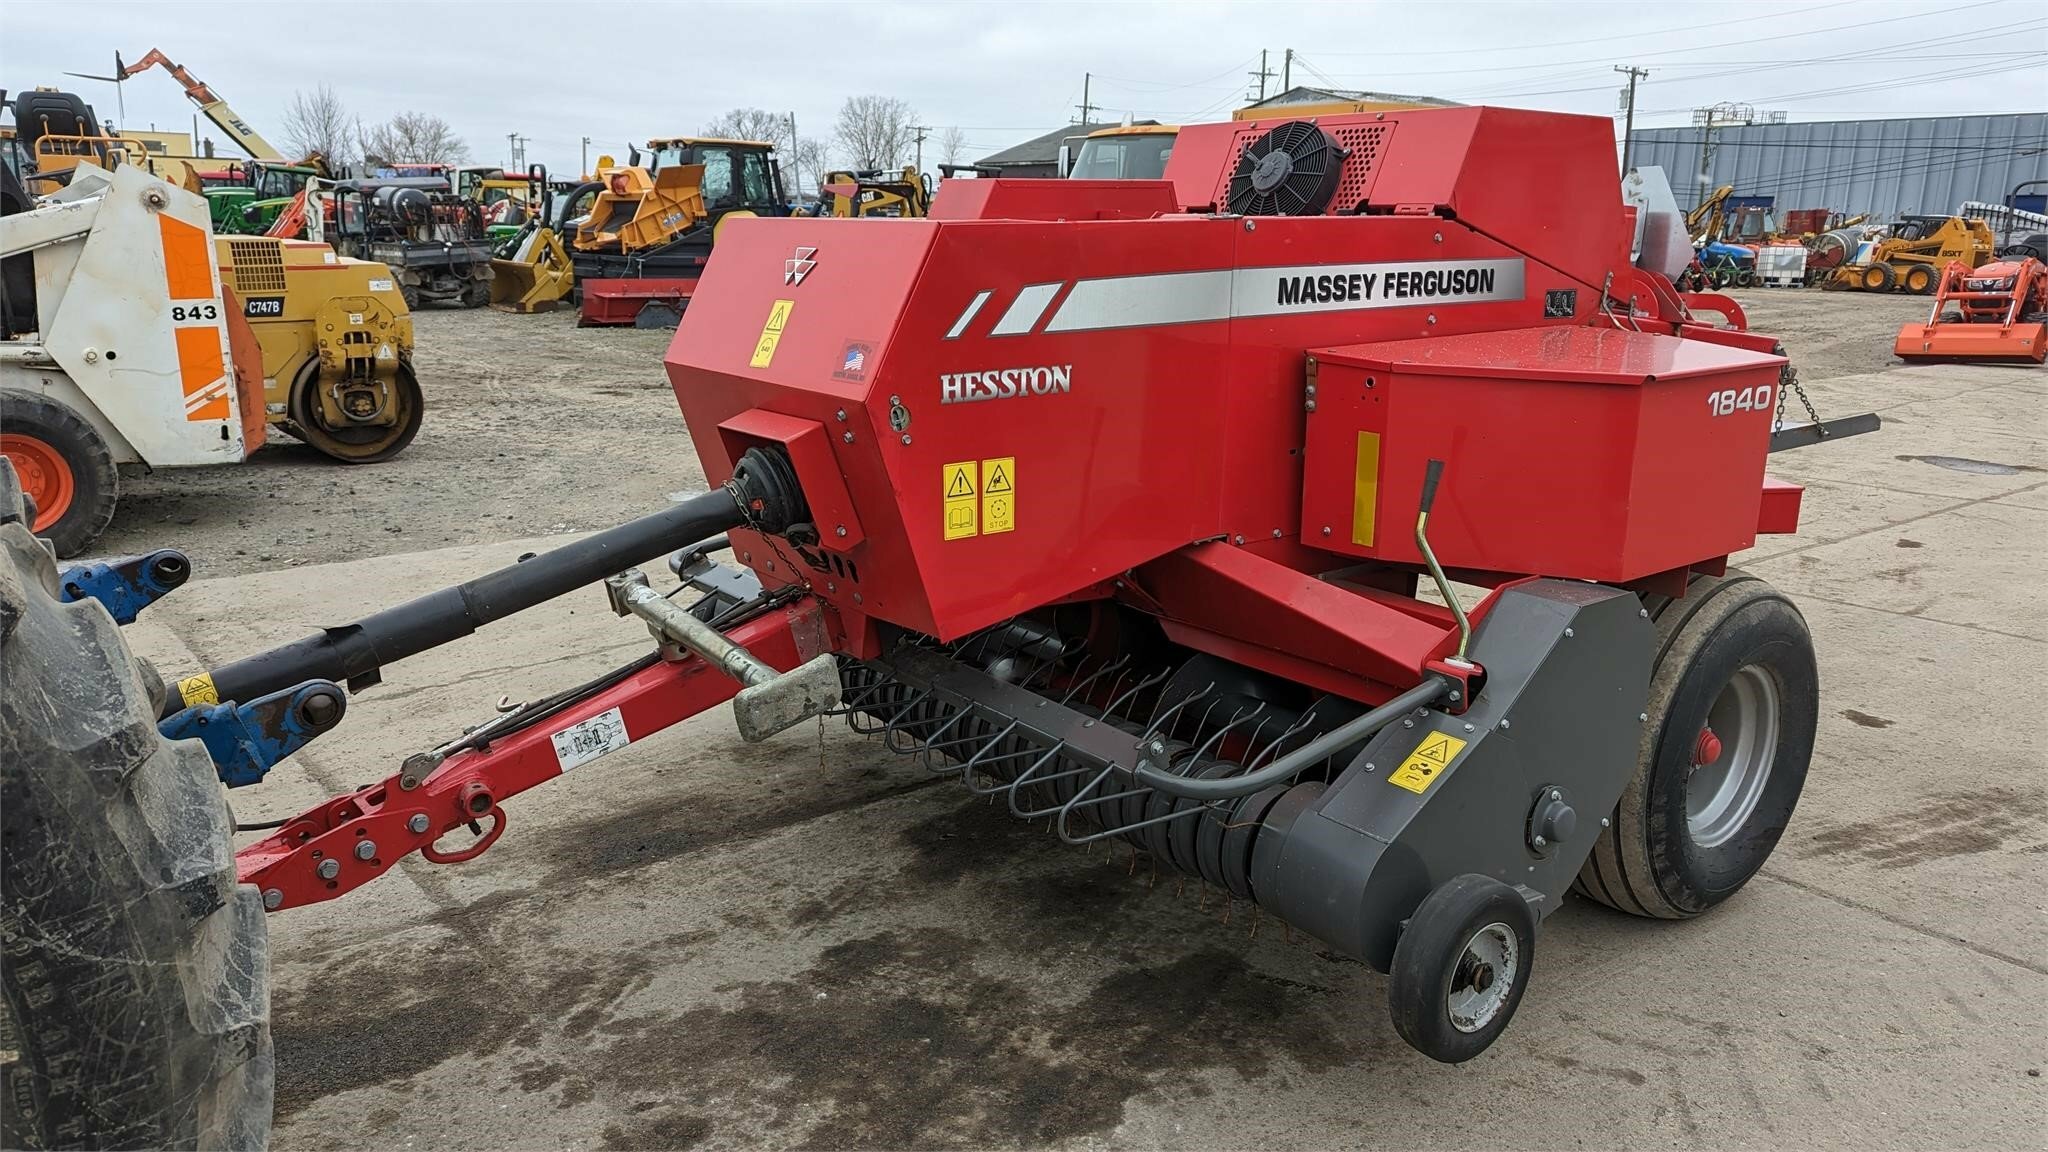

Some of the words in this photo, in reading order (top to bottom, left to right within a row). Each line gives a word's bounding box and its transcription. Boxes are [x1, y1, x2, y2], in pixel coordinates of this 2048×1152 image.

[228, 119, 253, 136] JLG
[861, 191, 875, 203] CAT
[1278, 273, 1377, 305] MASSEY
[1383, 268, 1495, 299] FERGUSON
[172, 305, 217, 321] 843
[248, 301, 280, 313] C747B
[940, 364, 1073, 405] HESSTON
[1707, 384, 1772, 417] 1840
[989, 519, 1009, 529] STOP
